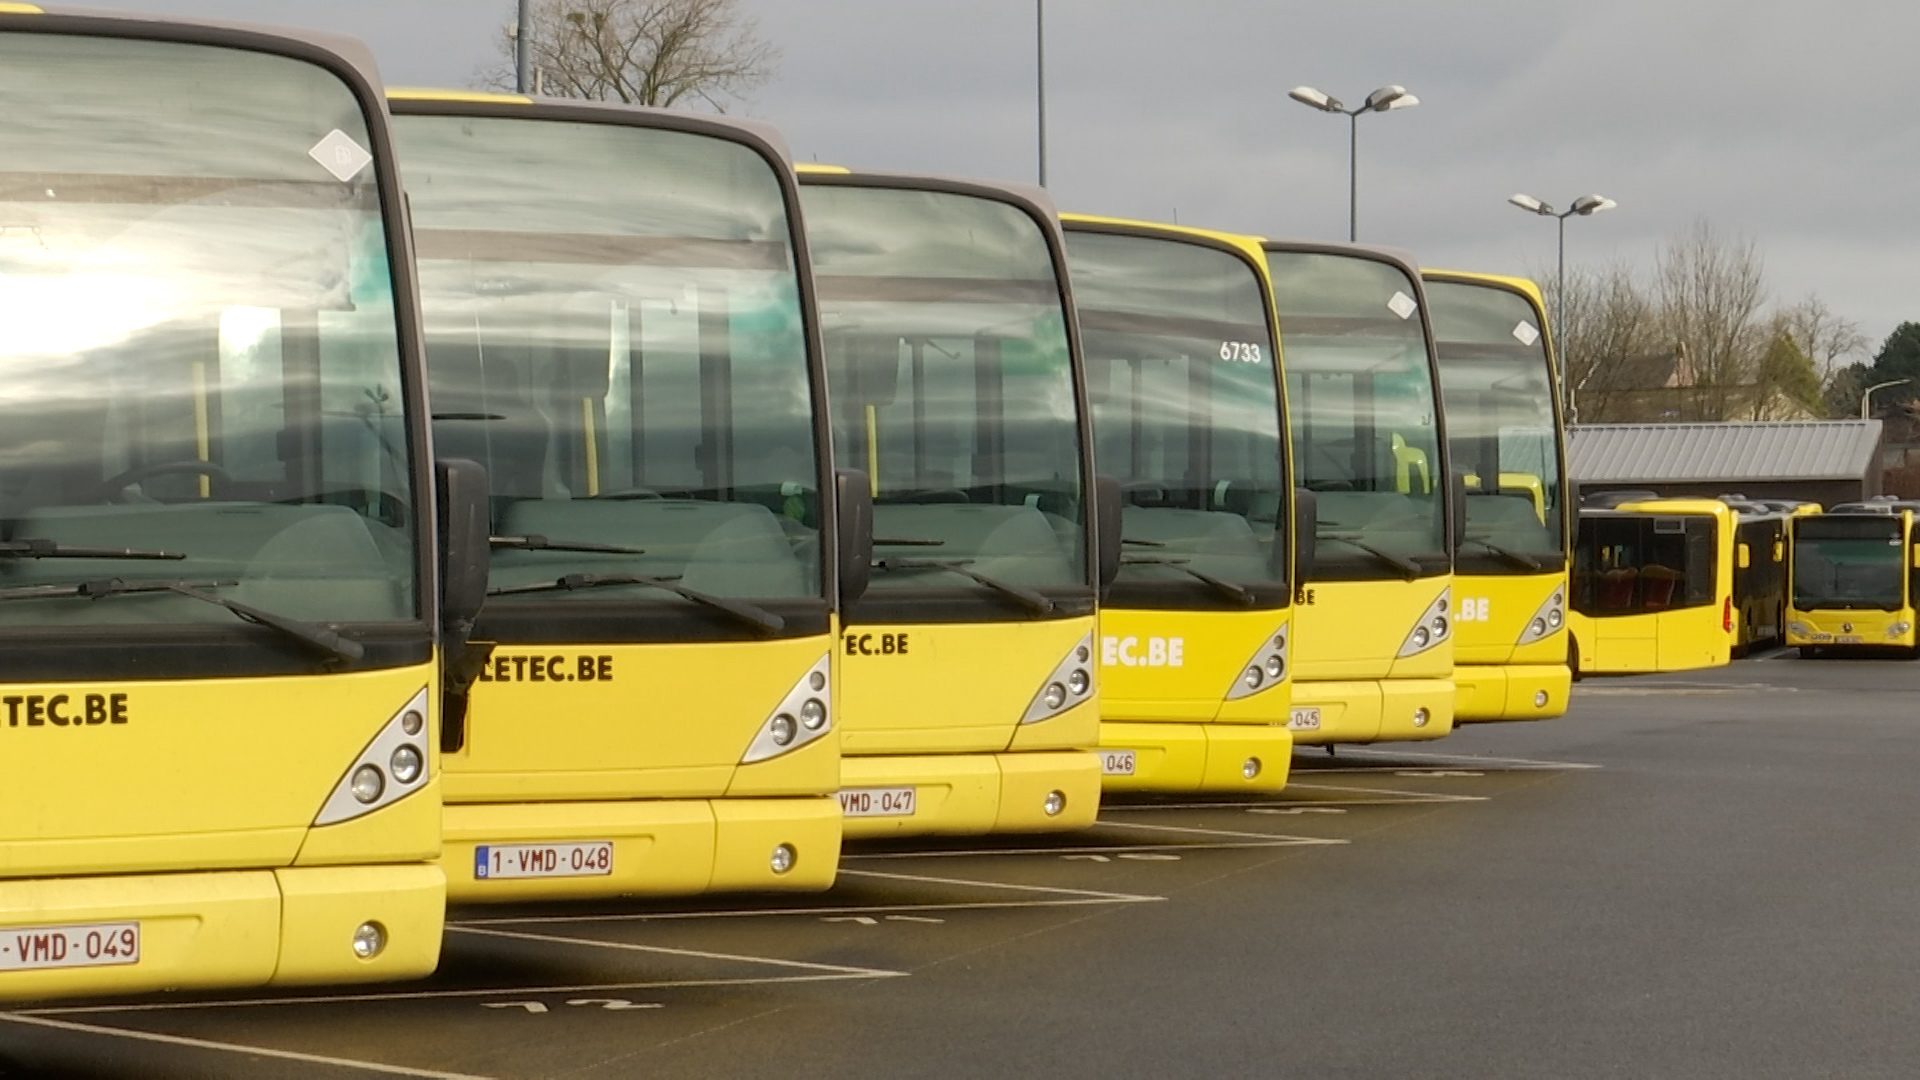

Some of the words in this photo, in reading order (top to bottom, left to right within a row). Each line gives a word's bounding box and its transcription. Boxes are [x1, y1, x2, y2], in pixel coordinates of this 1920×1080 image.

[1220, 341, 1261, 364] 6733
[841, 633, 908, 656] EC.BE
[1102, 635, 1184, 667] EC.BE
